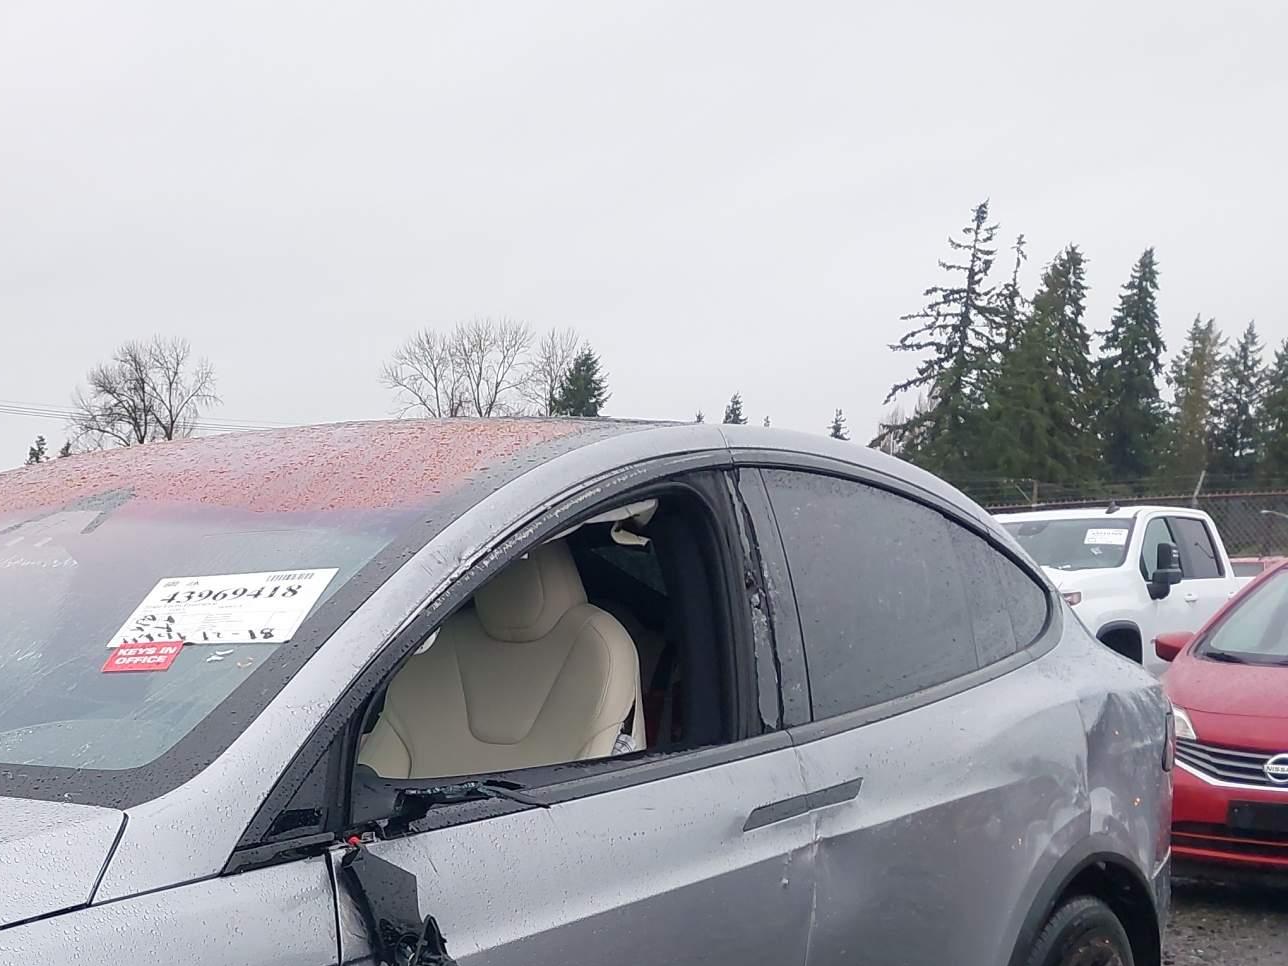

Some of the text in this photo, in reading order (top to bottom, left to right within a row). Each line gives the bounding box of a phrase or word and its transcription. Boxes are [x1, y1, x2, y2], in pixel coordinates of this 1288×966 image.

[160, 584, 302, 603] 43969418
[118, 646, 177, 656] KEYS IN
[115, 655, 168, 665] OFFICE
